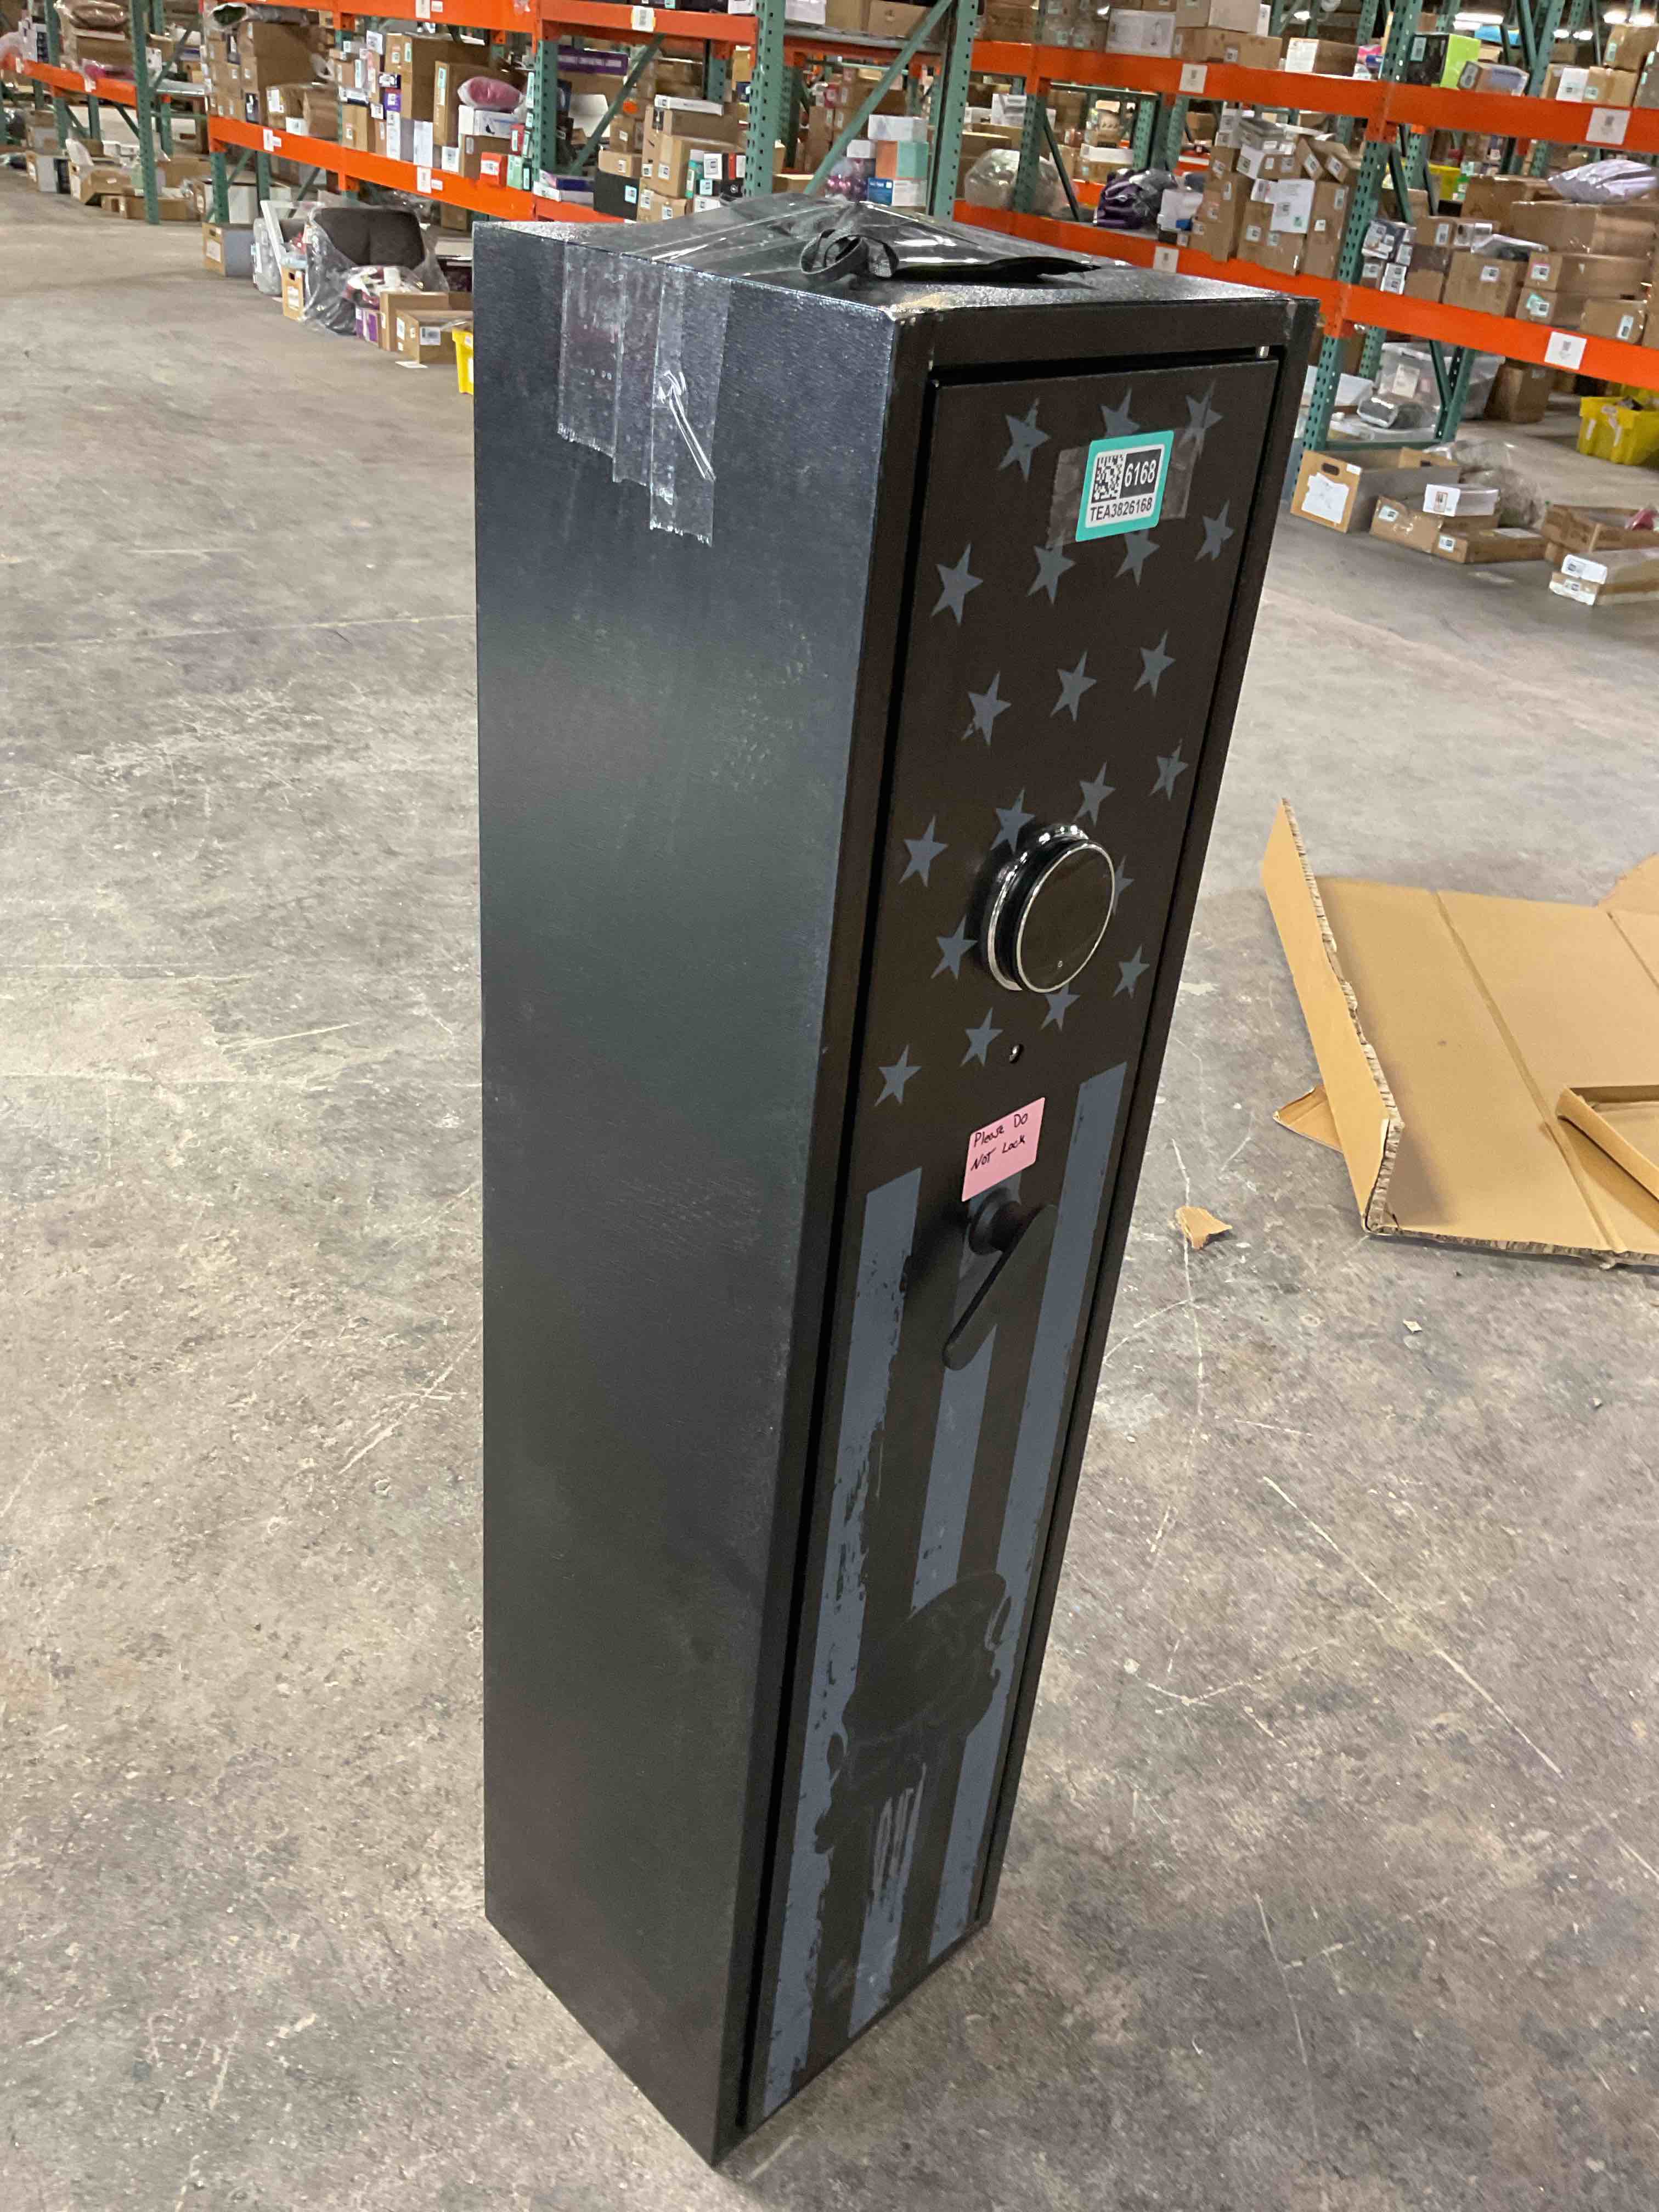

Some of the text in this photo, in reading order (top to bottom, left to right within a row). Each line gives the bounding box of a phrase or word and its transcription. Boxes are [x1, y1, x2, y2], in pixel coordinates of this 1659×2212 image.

[1125, 460, 1156, 487] 6168
[1090, 498, 1152, 521] TEA3826168
[974, 1125, 1004, 1147] Please
